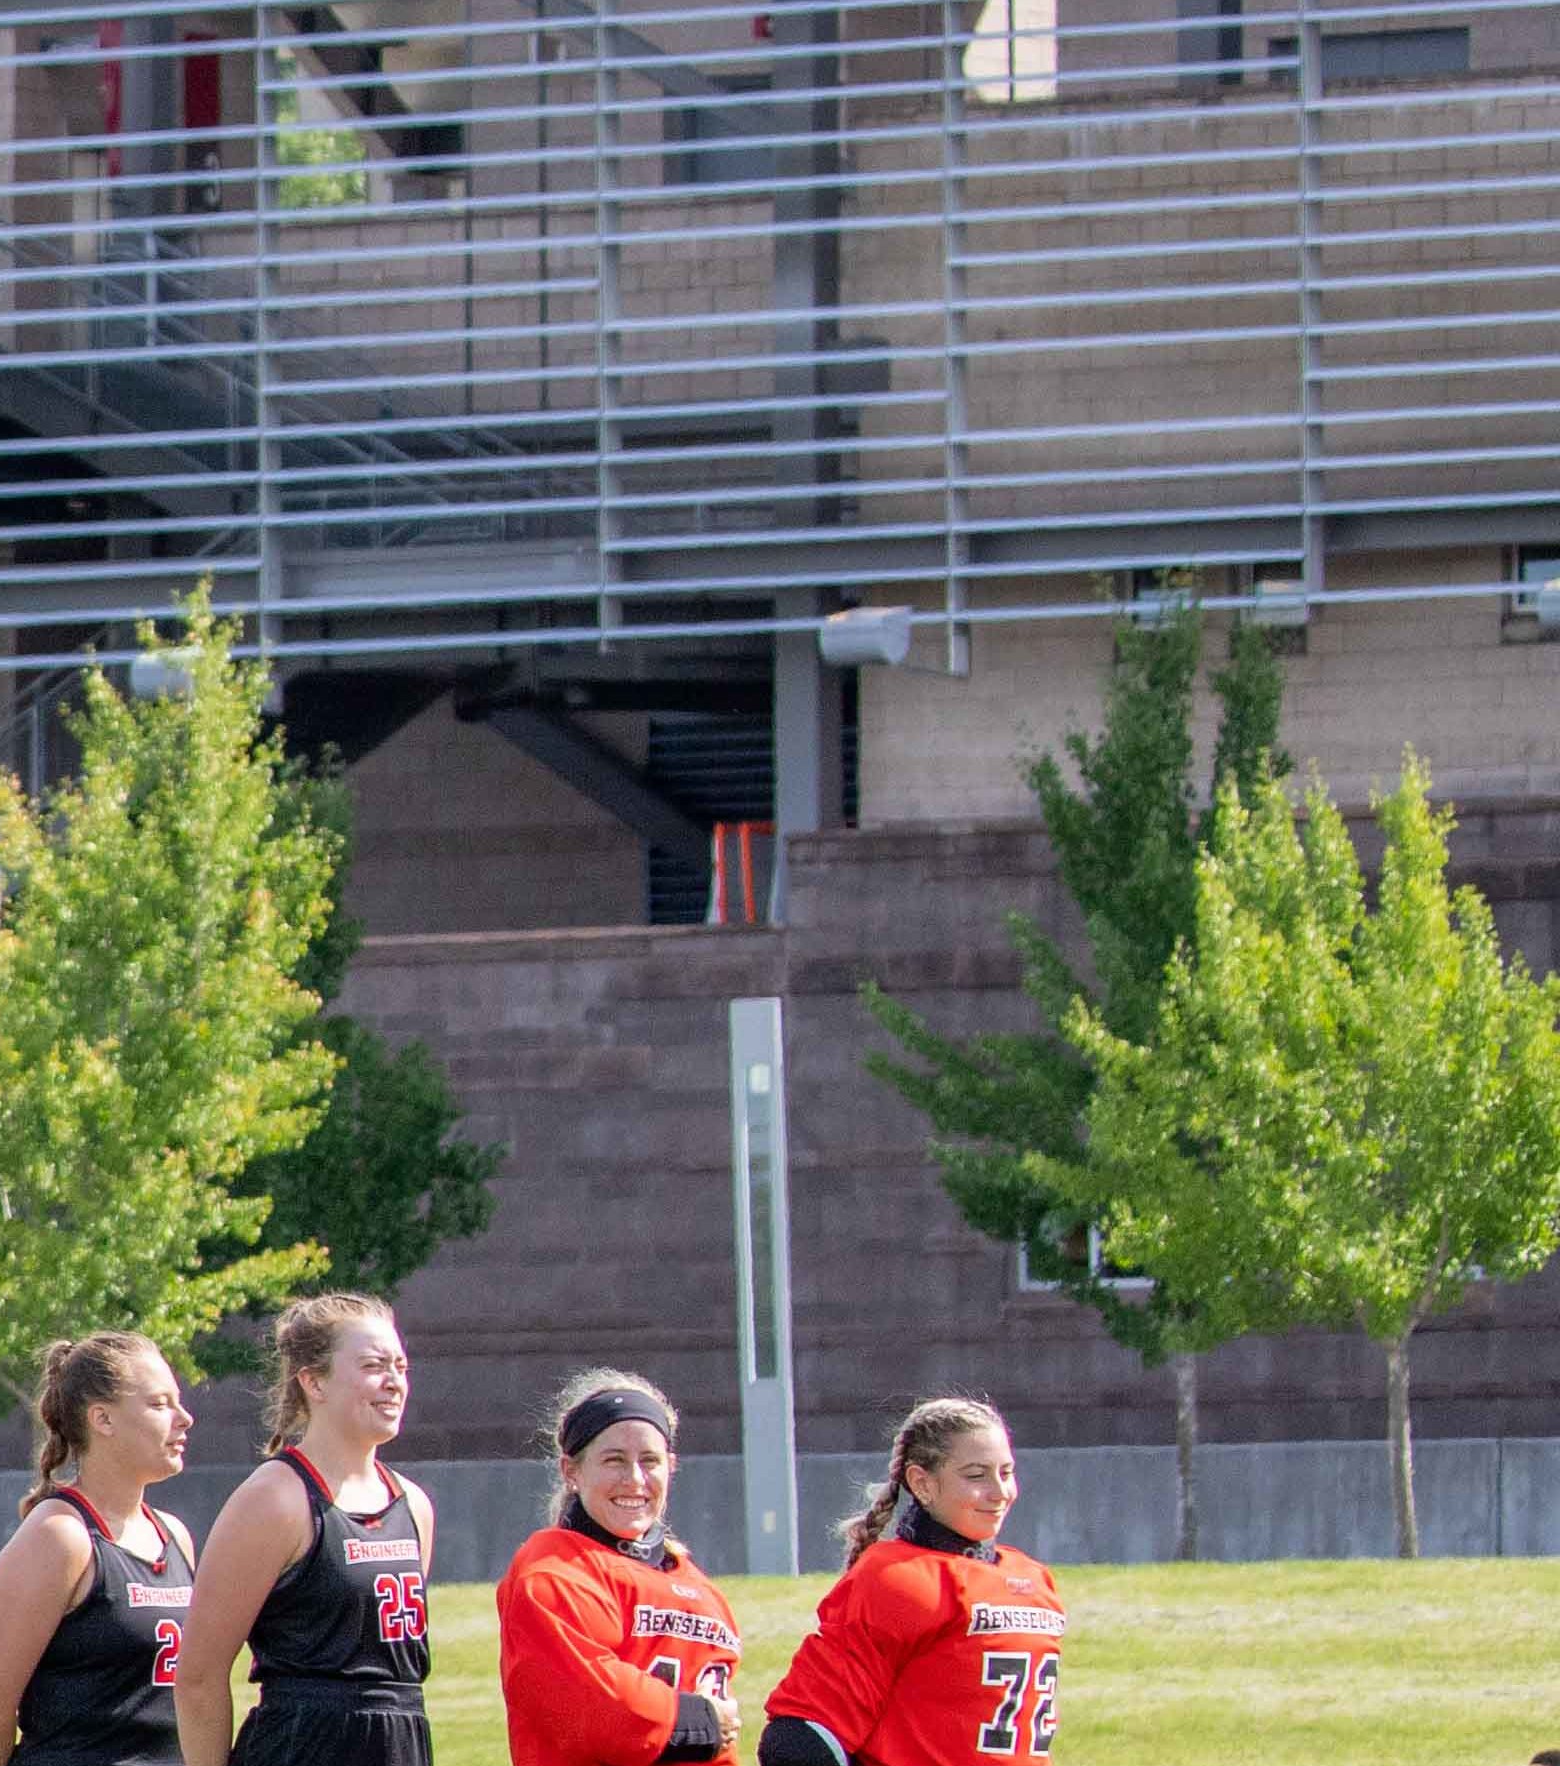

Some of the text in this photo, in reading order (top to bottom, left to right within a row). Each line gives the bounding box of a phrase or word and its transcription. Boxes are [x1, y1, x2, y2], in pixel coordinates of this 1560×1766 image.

[373, 1572, 428, 1642] 25
[152, 1619, 183, 1686] 2
[976, 1652, 1059, 1757] 72
